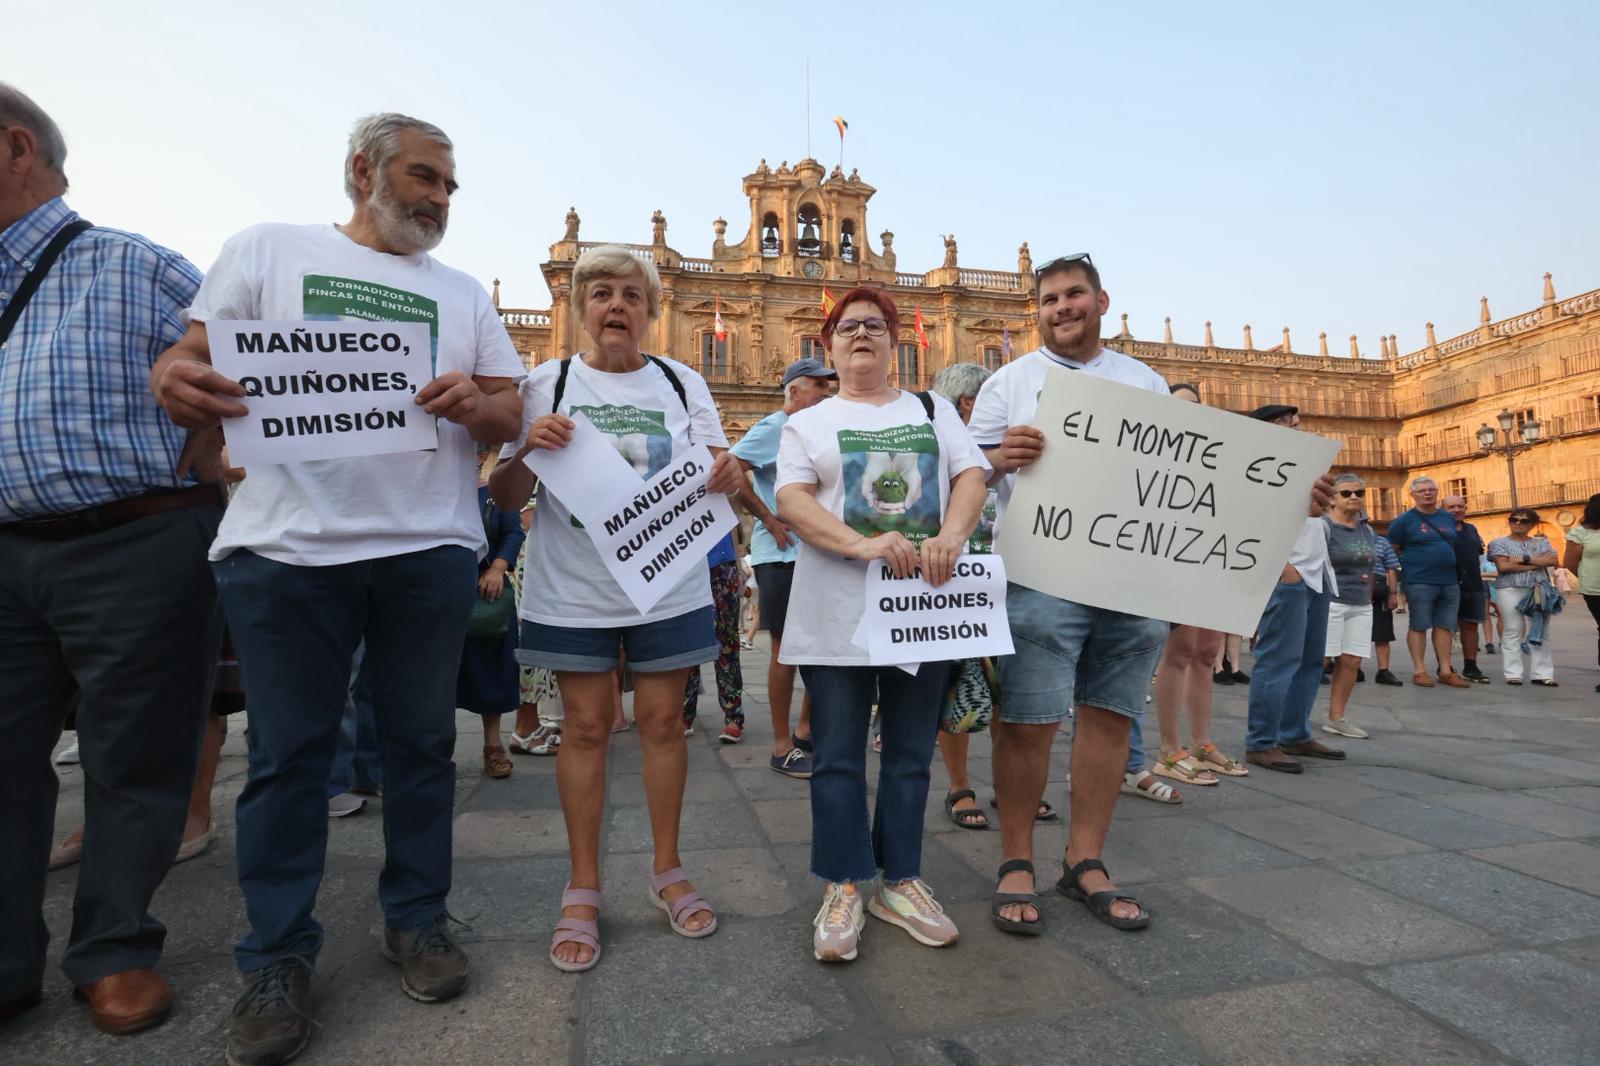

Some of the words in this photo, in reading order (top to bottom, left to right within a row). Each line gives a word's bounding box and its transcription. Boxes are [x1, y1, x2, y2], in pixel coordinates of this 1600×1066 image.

[308, 288, 353, 299] FINCAS
[356, 294, 379, 305] DEL
[381, 299, 434, 318] ENTORNO
[329, 280, 404, 301] TORNADIZOS
[235, 328, 410, 356] MAÑUECO,
[238, 370, 417, 398] QUIÑONES,
[261, 407, 406, 438] DIMISIÓN
[894, 433, 935, 444] ENTORNO
[1063, 410, 1100, 443] EL
[1117, 418, 1224, 470] MOMTE
[1245, 456, 1297, 488] ES
[604, 461, 704, 536] MAÑUECO,
[1032, 503, 1073, 541] NO
[640, 510, 715, 583] DIMISIÓN
[879, 592, 994, 613] QUIÑONES,
[890, 620, 988, 643] DIMISIÓN
